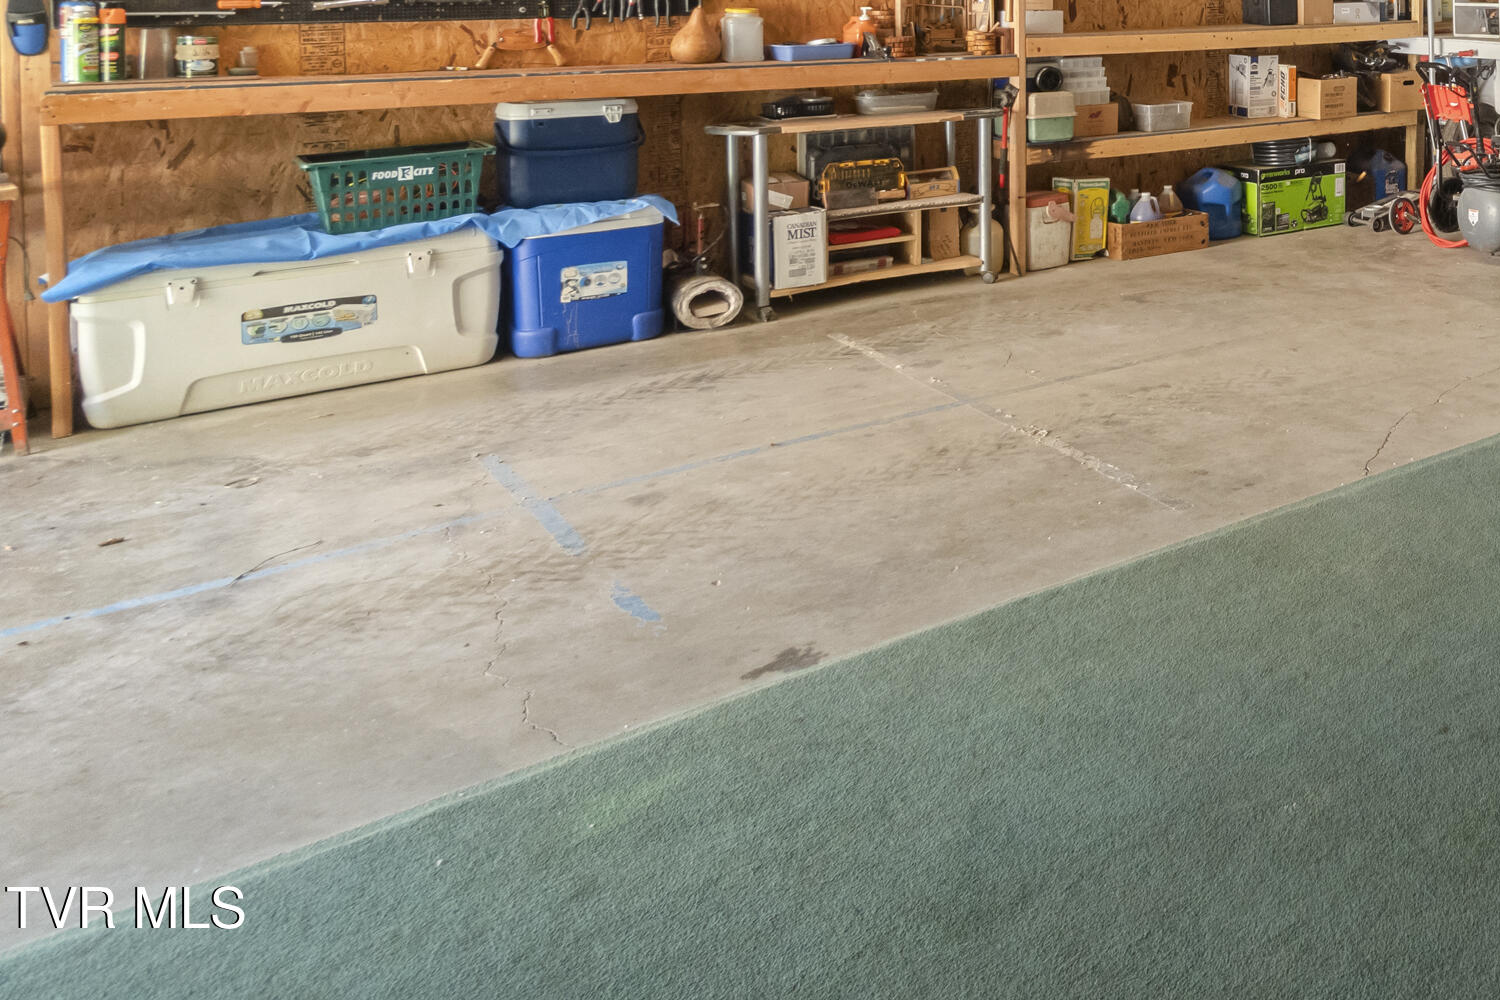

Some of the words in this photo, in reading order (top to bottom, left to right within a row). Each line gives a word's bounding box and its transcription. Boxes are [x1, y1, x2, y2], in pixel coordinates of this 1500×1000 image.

[1279, 70, 1287, 102] ECHO
[371, 170, 398, 181] FOOD
[413, 166, 435, 176] CITY
[1294, 168, 1306, 176] pro
[787, 220, 817, 230] CANADIAN
[787, 227, 817, 241] MIST
[283, 300, 337, 314] MAXCOLD
[240, 359, 373, 393] MAXCOLD
